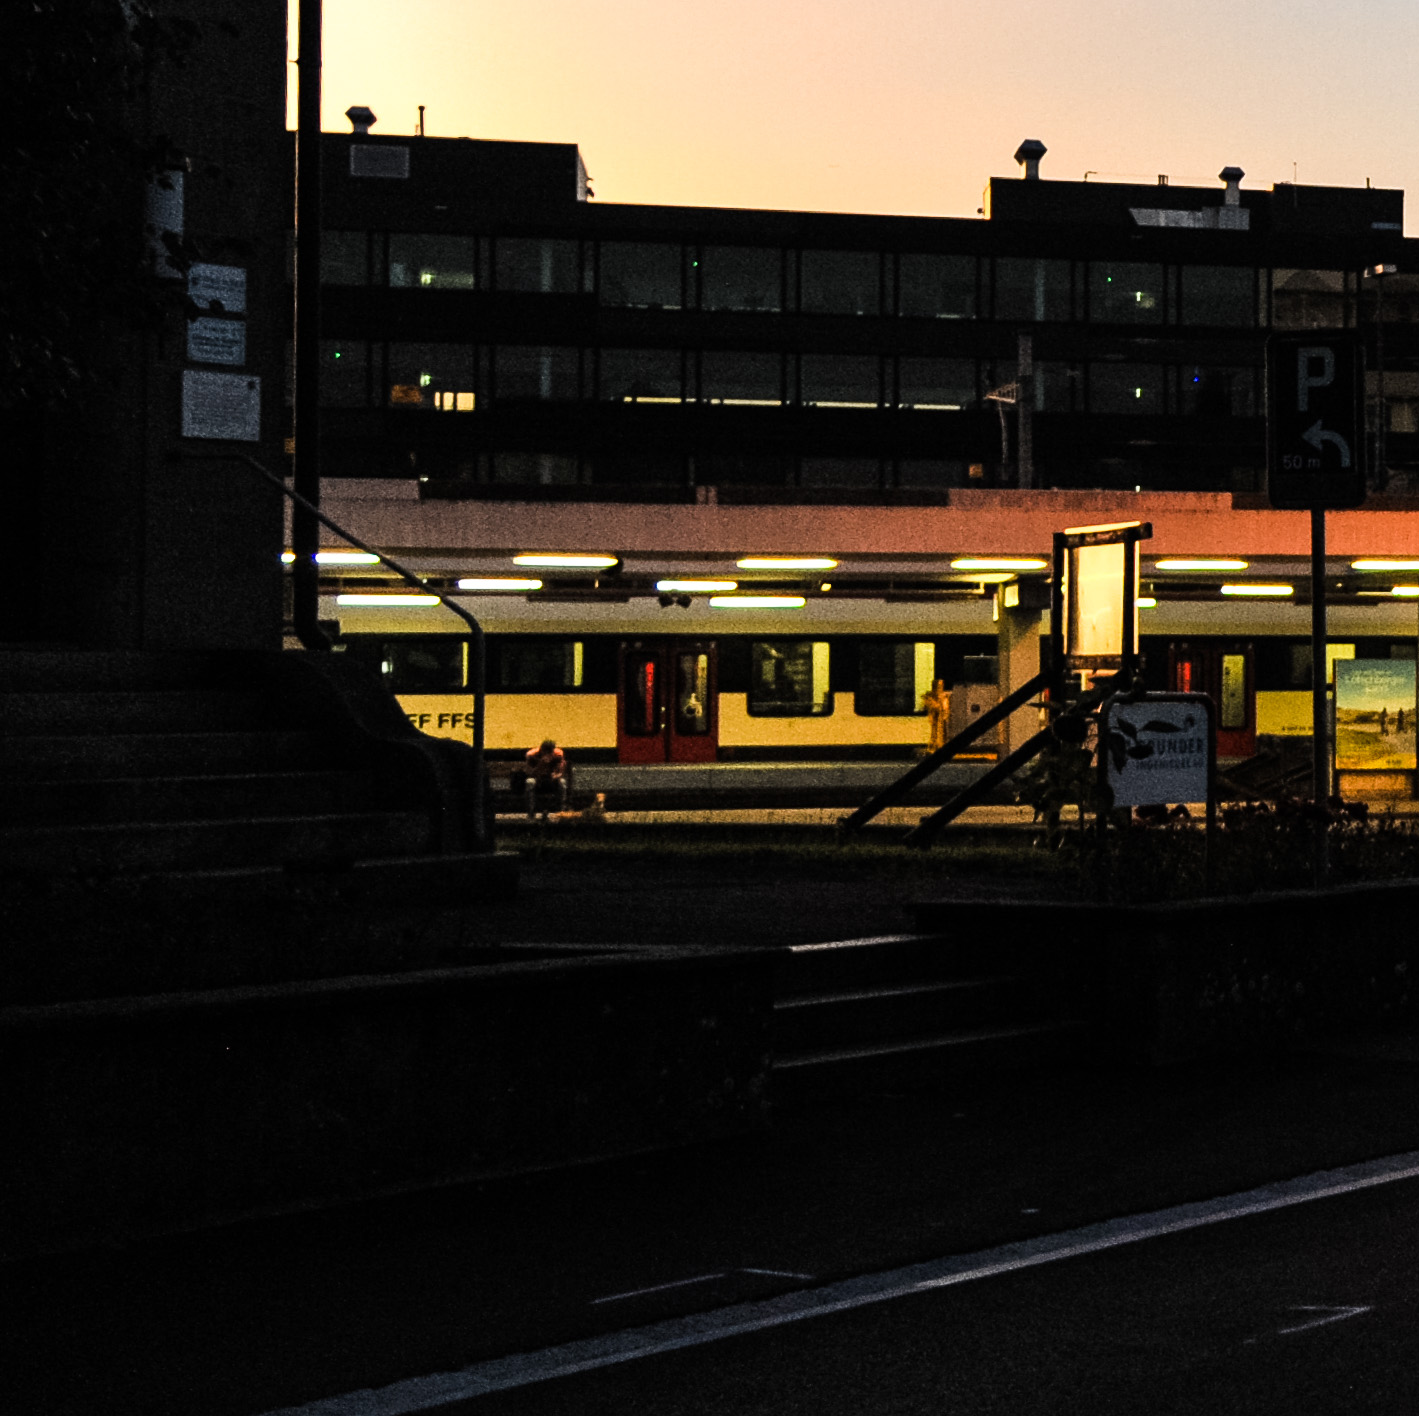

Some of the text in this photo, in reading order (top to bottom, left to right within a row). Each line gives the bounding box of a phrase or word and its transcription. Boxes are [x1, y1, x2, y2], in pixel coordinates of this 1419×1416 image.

[1297, 346, 1335, 412] P
[1283, 455, 1321, 470] 50 m
[438, 712, 475, 730] FFS
